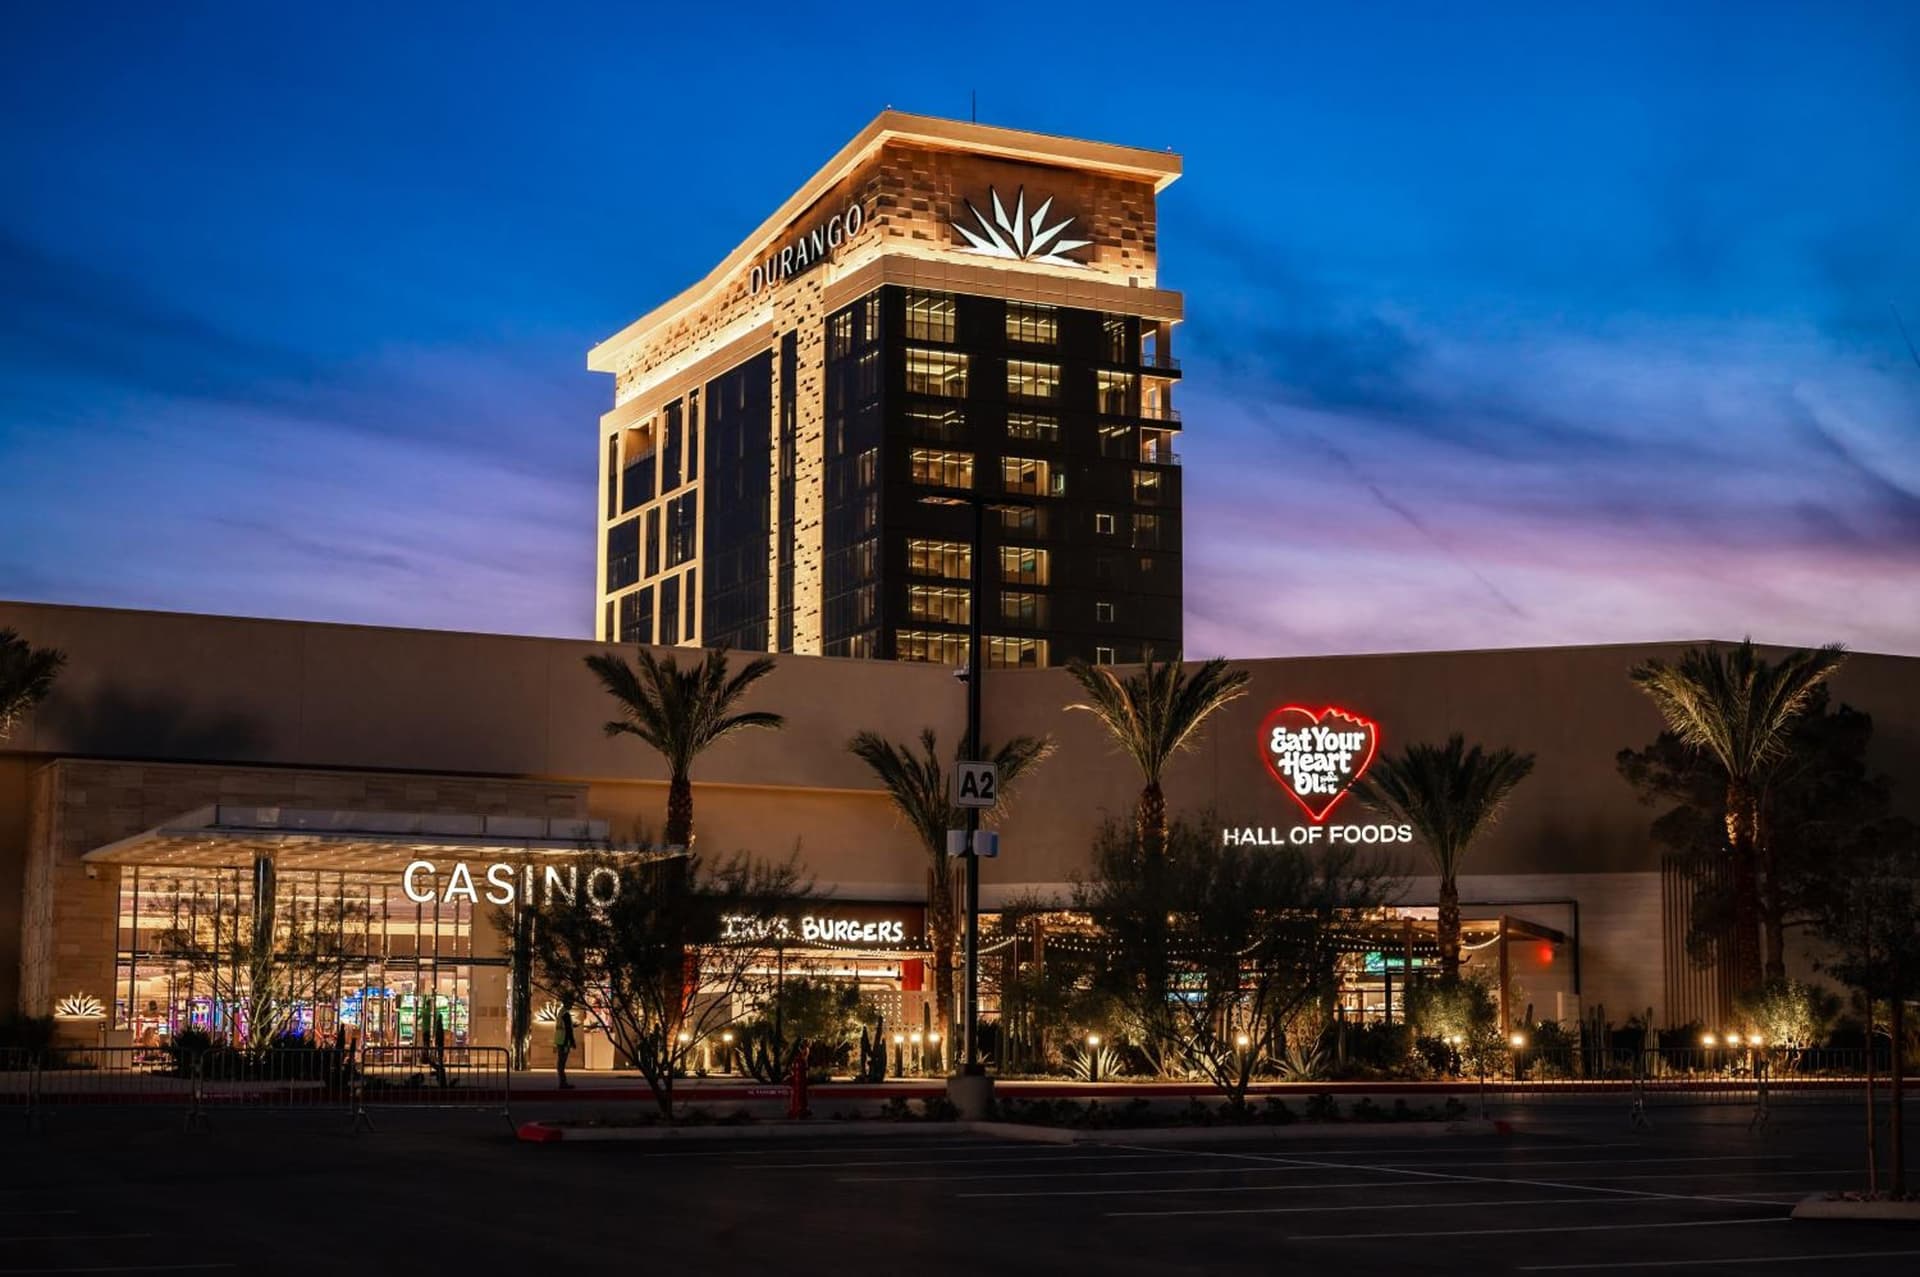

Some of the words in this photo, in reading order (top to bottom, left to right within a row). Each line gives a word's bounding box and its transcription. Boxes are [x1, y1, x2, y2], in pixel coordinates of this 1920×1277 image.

[750, 204, 863, 297] DURANGO
[1270, 727, 1312, 753] Eat
[1311, 726, 1366, 753] Your
[1278, 750, 1353, 775] Heart
[960, 771, 994, 799] A2
[1294, 771, 1339, 795] Out
[1223, 827, 1285, 846] HALL
[1290, 826, 1324, 845] OF
[1329, 825, 1413, 844] FOODS
[402, 860, 621, 907] CASINO
[802, 916, 905, 943] BURGERS
